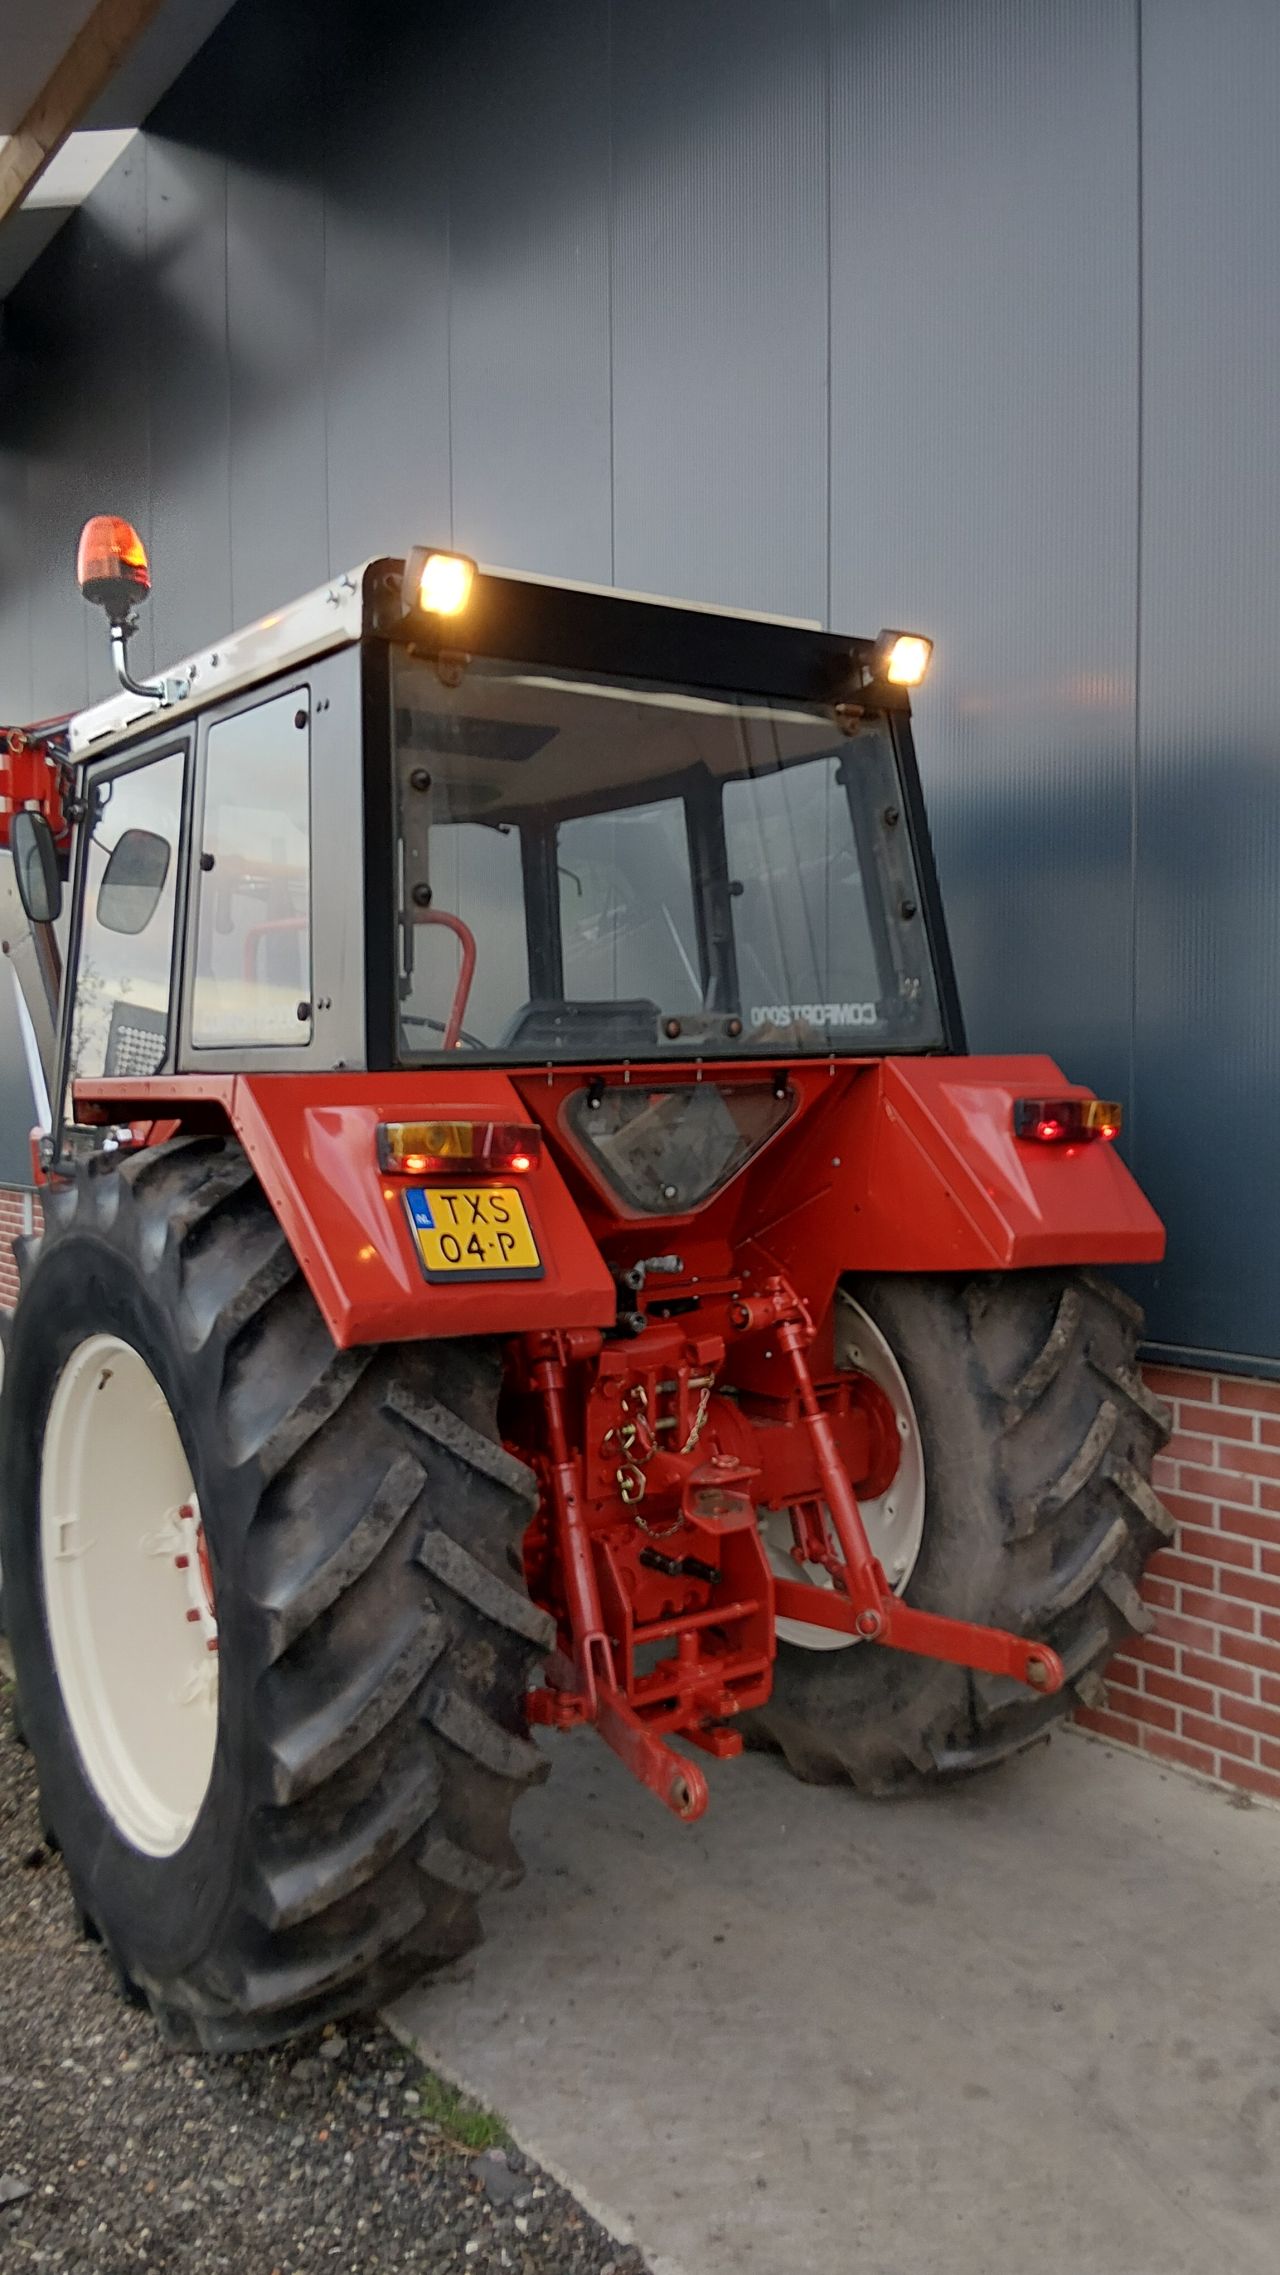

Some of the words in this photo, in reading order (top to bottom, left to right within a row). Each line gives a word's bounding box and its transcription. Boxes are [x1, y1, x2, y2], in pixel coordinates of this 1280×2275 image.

[415, 1213, 431, 1225] NL
[440, 1194, 510, 1225] TXS
[440, 1232, 515, 1263] 04-P
